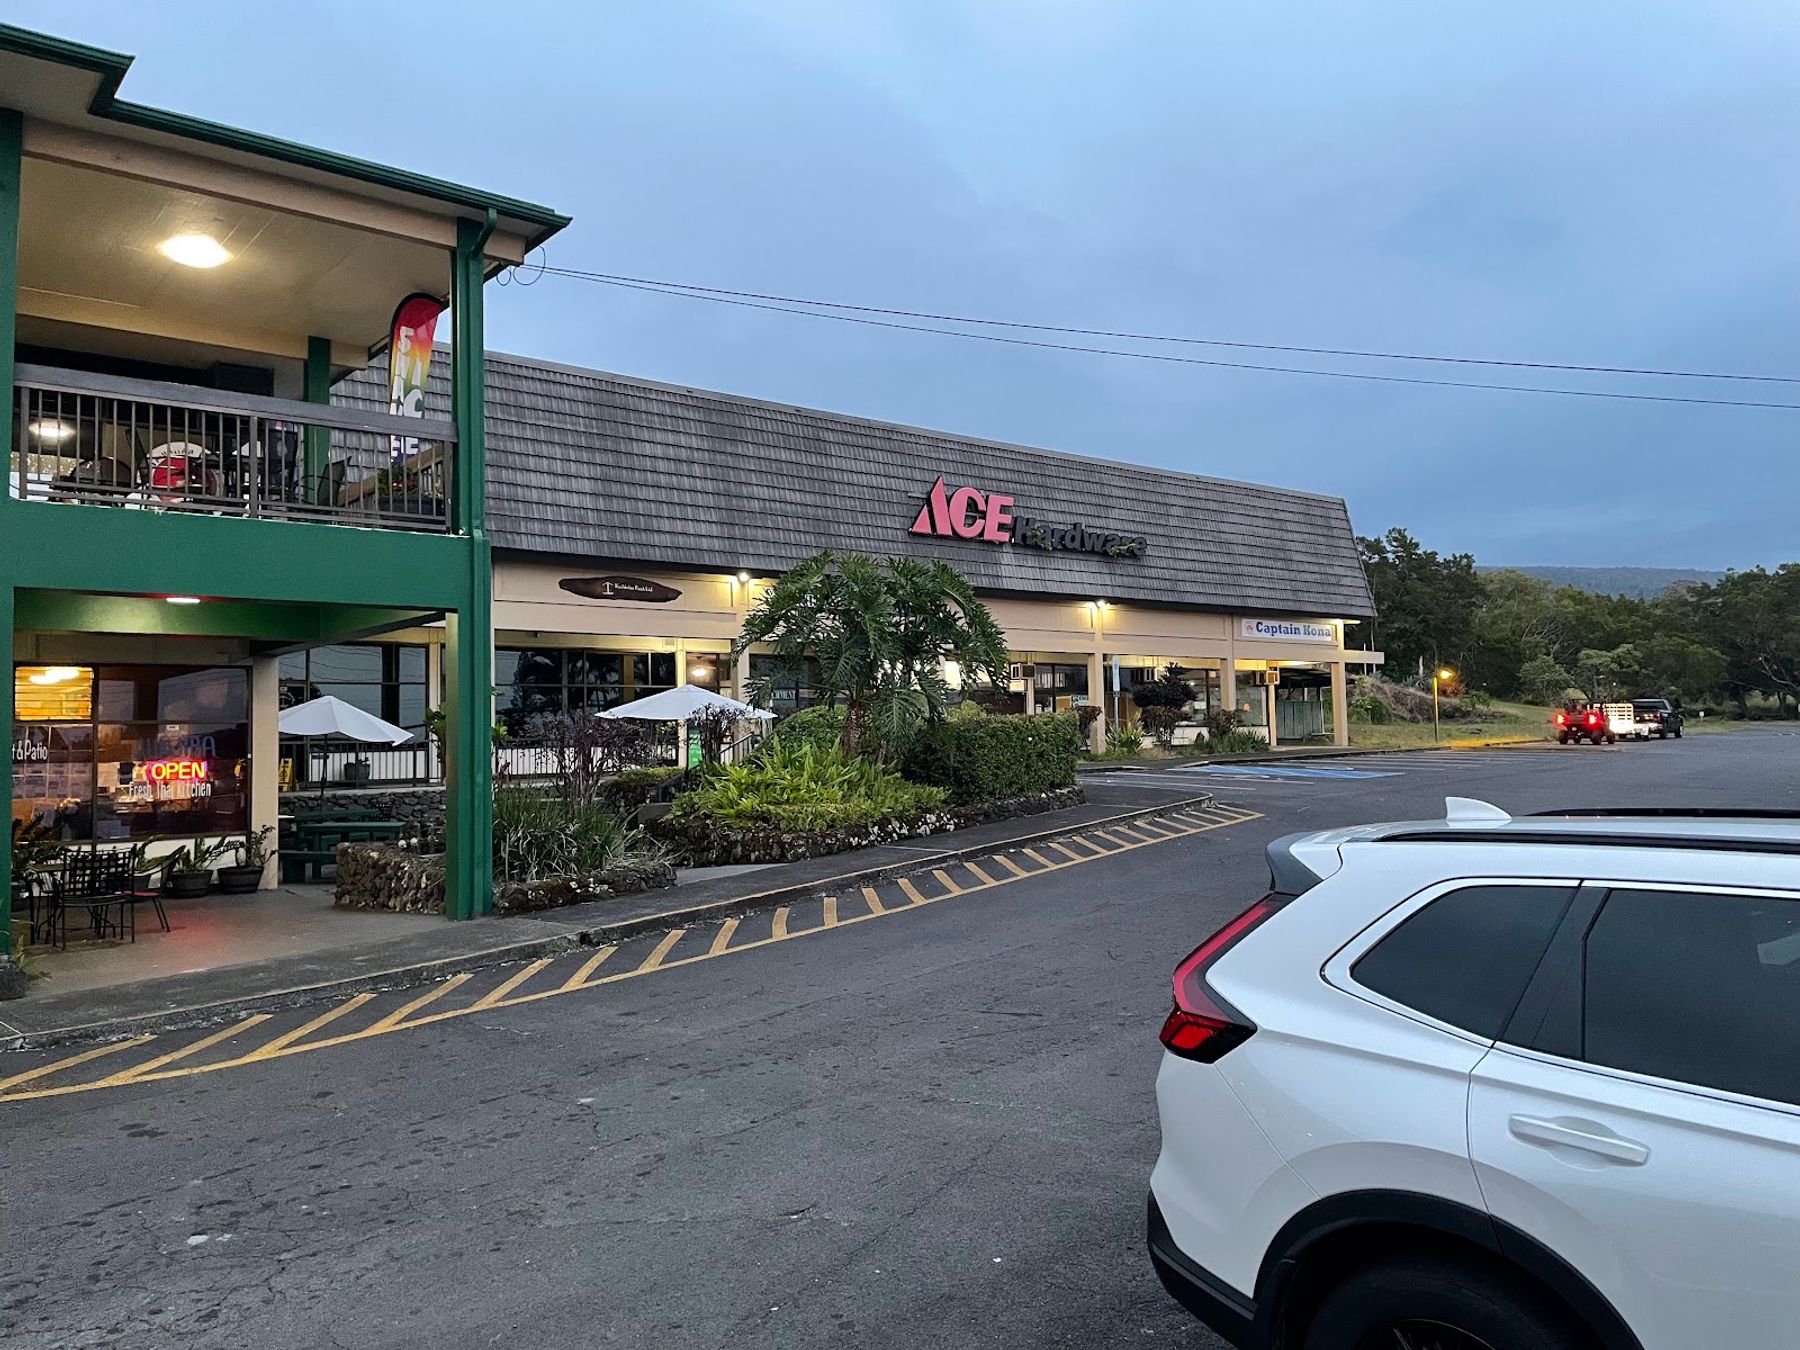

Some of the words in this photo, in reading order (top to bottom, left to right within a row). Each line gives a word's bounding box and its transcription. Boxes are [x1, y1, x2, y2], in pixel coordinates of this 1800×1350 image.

[910, 475, 1014, 542] ACE
[1014, 516, 1148, 557] Hardware
[1256, 621, 1301, 637] Captain
[1302, 625, 1331, 637] Kona
[151, 761, 205, 780] OPEN
